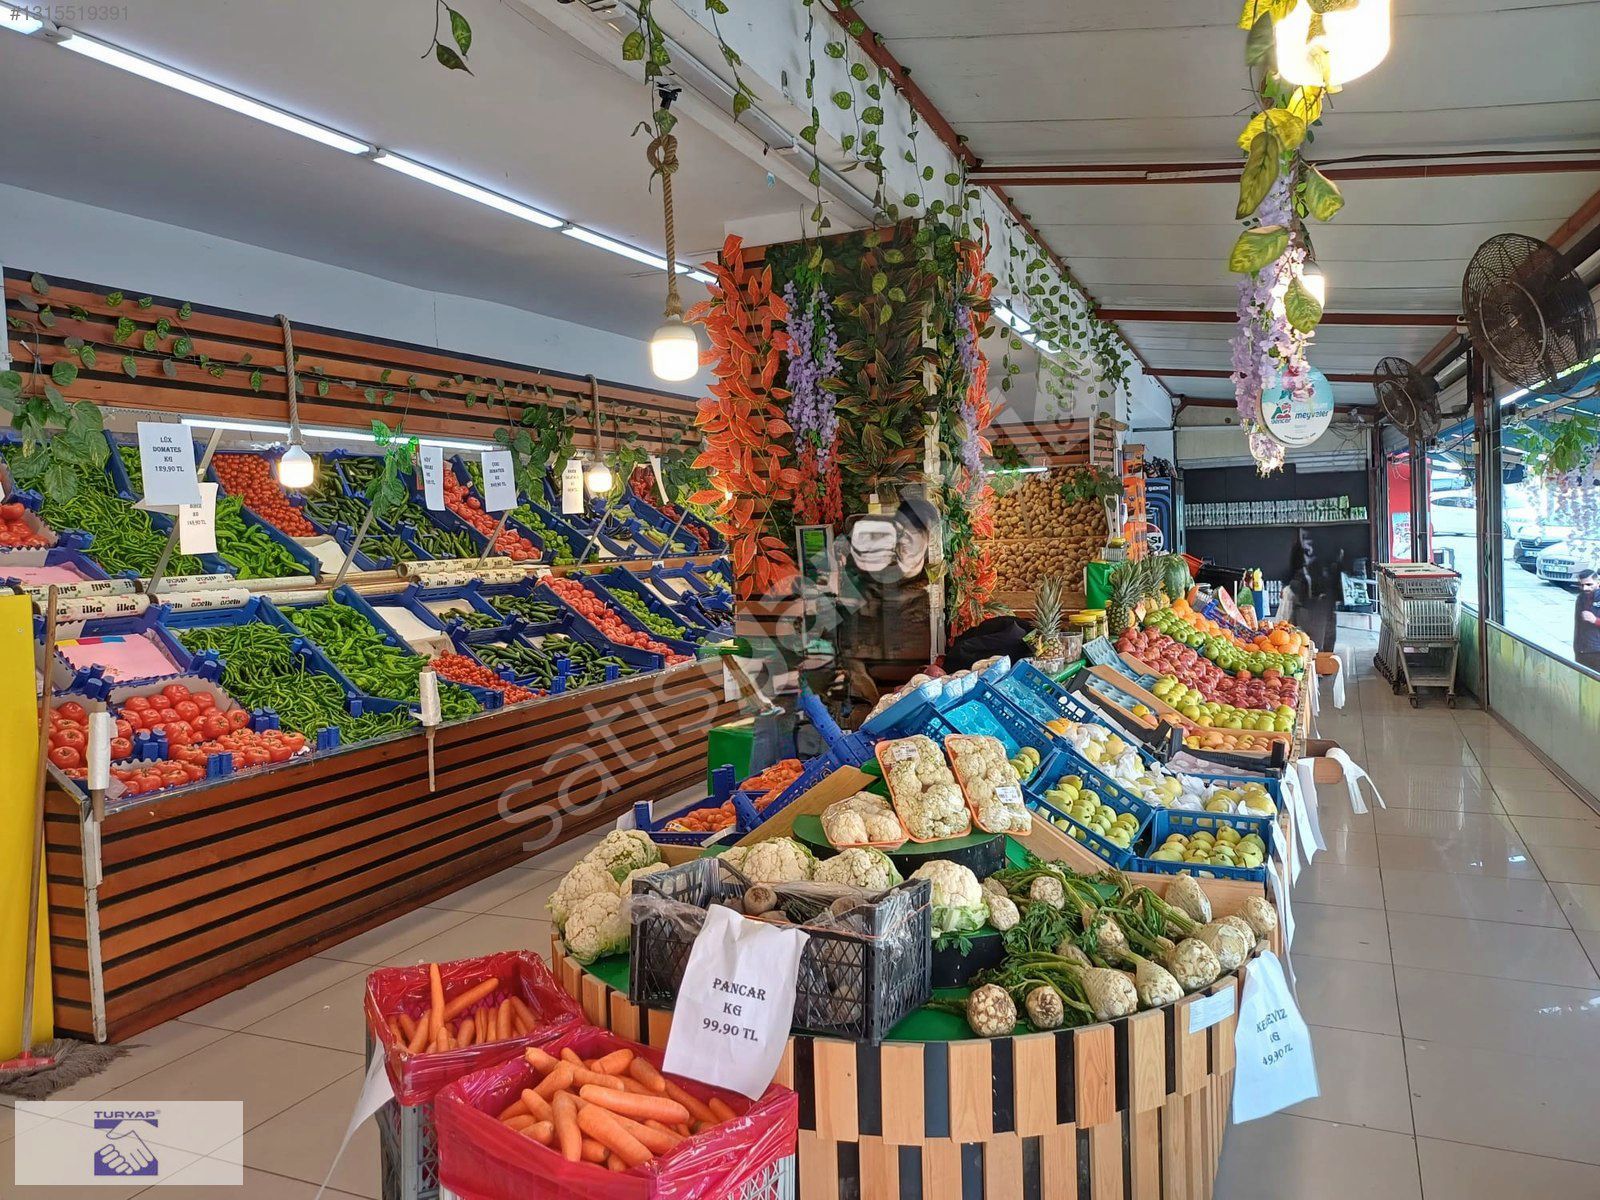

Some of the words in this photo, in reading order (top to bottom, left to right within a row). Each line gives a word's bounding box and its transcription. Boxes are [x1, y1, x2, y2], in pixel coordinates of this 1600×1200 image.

[82, 605, 103, 614] ilka
[116, 603, 136, 612] ilka
[712, 977, 767, 1001] PANCAR
[722, 1002, 743, 1017] KG
[702, 1017, 740, 1036] 99,90
[743, 1027, 758, 1042] TL
[1284, 1043, 1293, 1054] TL
